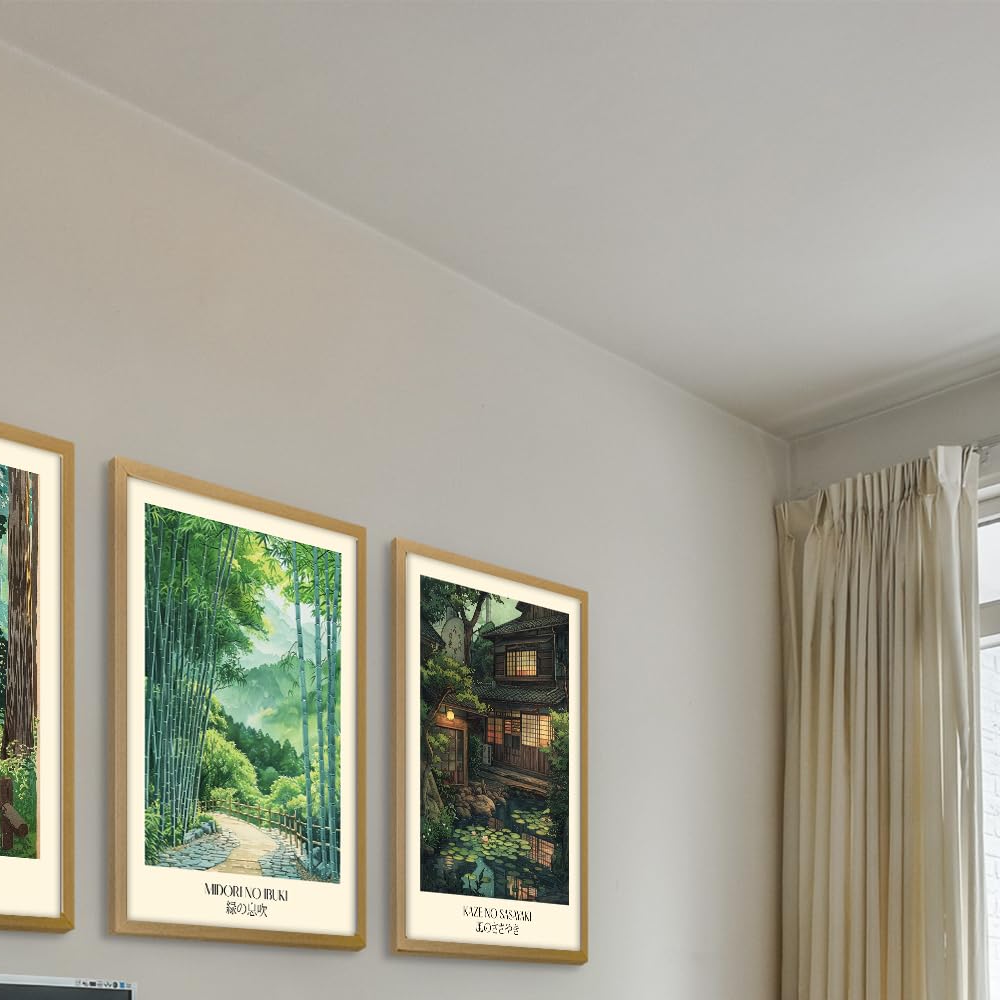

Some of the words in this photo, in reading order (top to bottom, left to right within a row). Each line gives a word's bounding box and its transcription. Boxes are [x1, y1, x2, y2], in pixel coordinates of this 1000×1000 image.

[205, 883, 242, 898] MIDORI
[245, 886, 261, 899] NO
[264, 888, 288, 901] IBUKI
[485, 908, 497, 919] NO
